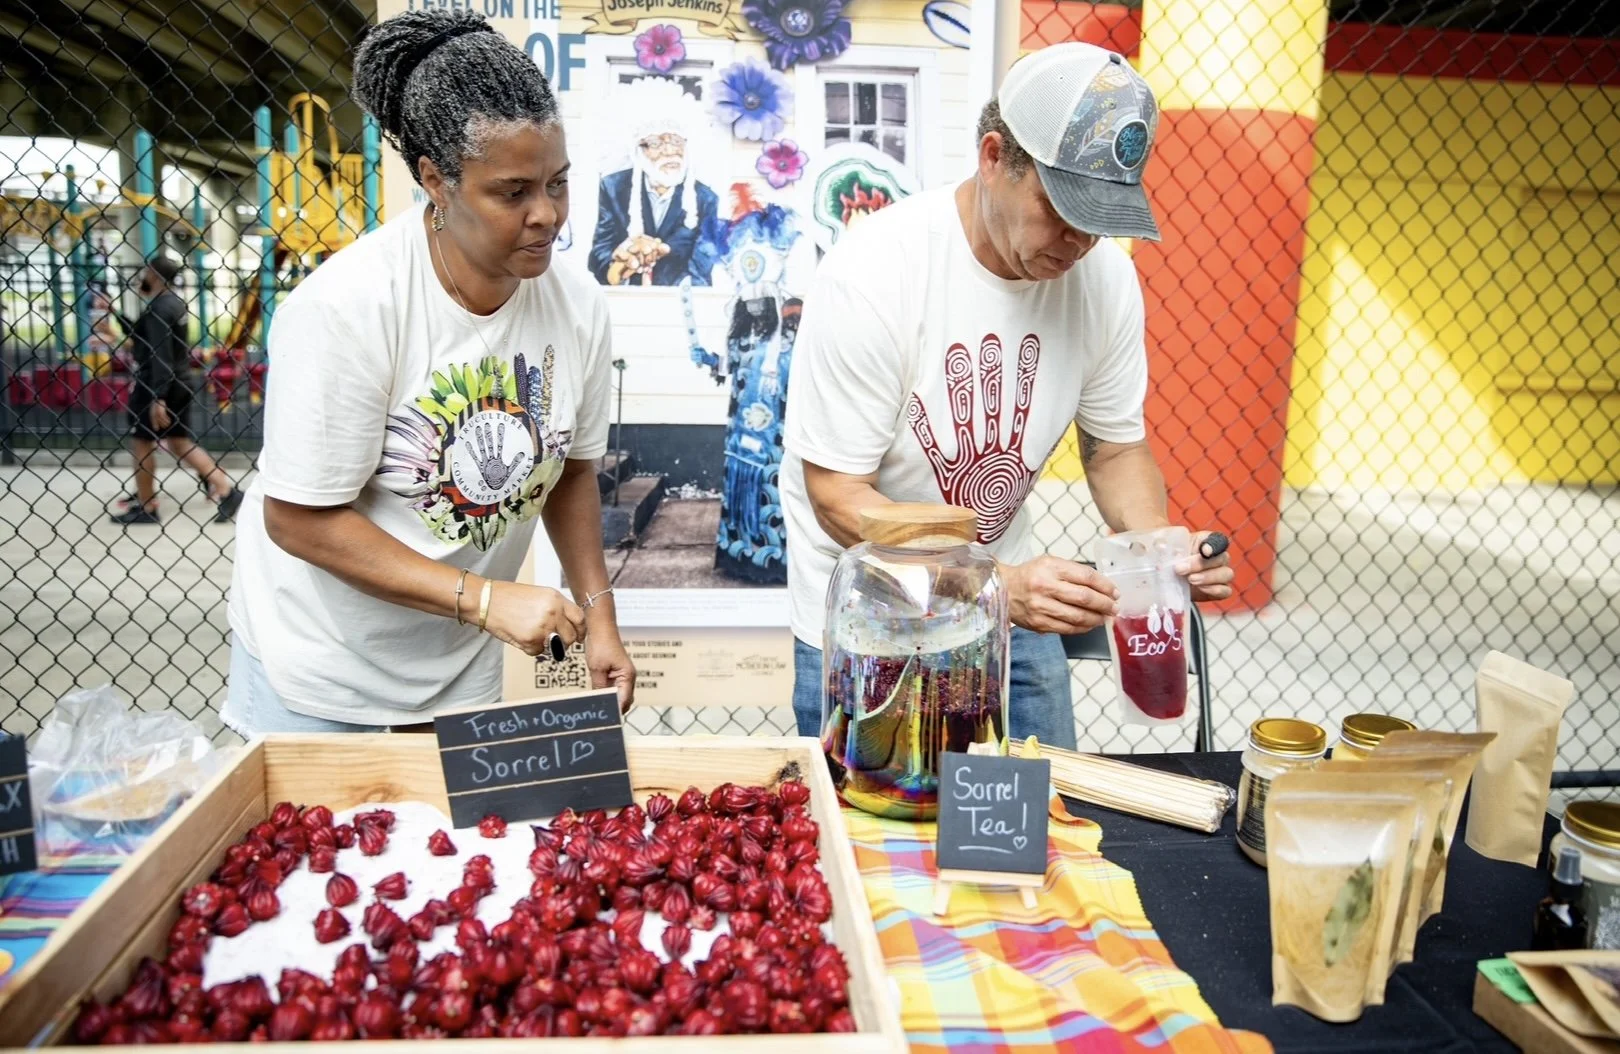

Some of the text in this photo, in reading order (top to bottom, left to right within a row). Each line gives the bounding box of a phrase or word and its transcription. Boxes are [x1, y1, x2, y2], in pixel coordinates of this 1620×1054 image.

[484, 0, 513, 18] ON
[524, 0, 561, 19] THE
[608, 0, 722, 13] Joseph Jenkins
[453, 457, 534, 501] COMMUNITY MARKET
[464, 710, 529, 739] Fresh
[541, 706, 609, 730] Organic
[471, 740, 561, 784] Sorrel
[953, 766, 1019, 802] Sorrel
